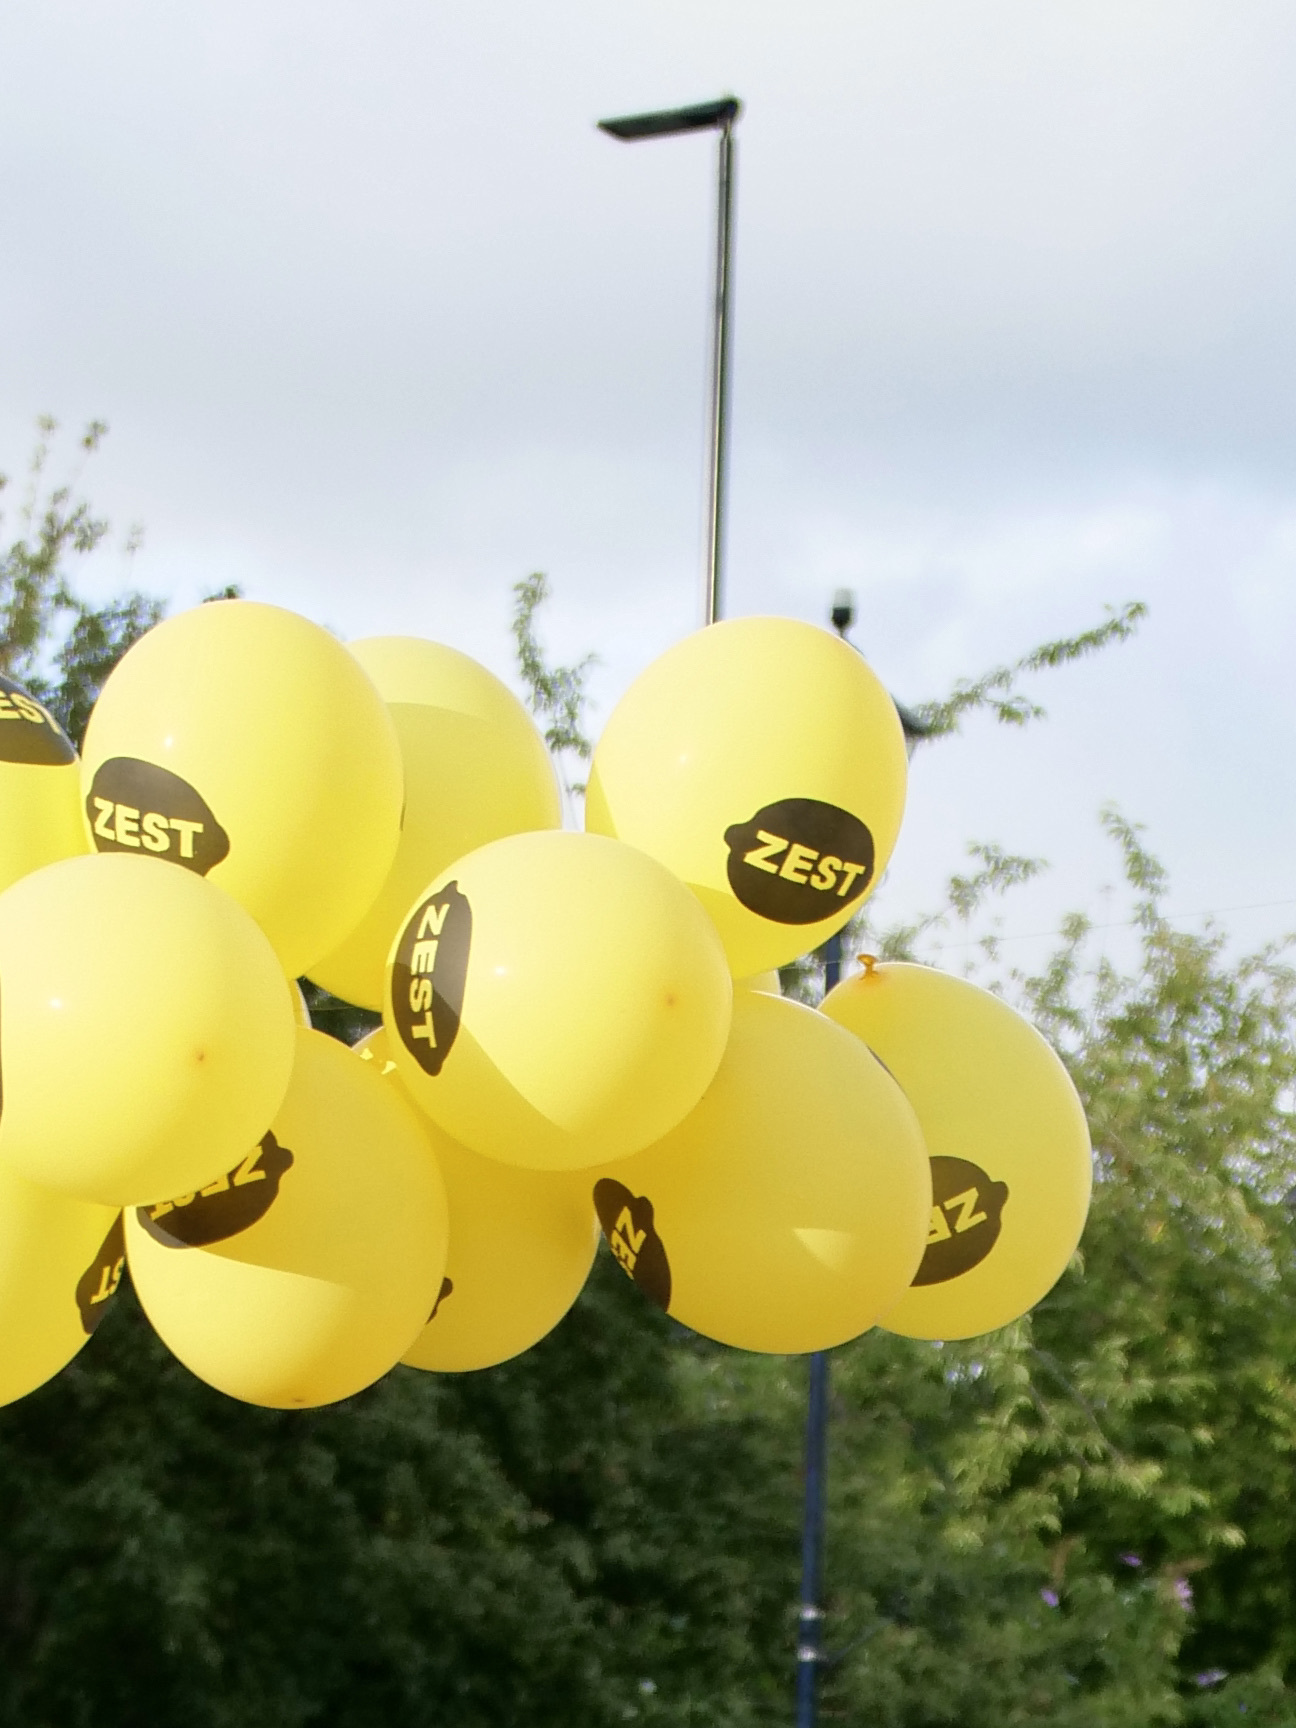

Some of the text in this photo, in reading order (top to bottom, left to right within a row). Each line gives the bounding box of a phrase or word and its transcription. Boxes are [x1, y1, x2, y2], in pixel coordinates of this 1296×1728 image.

[94, 796, 203, 858] ZEST
[743, 829, 866, 897] ZEST
[409, 904, 450, 1048] ZEST
